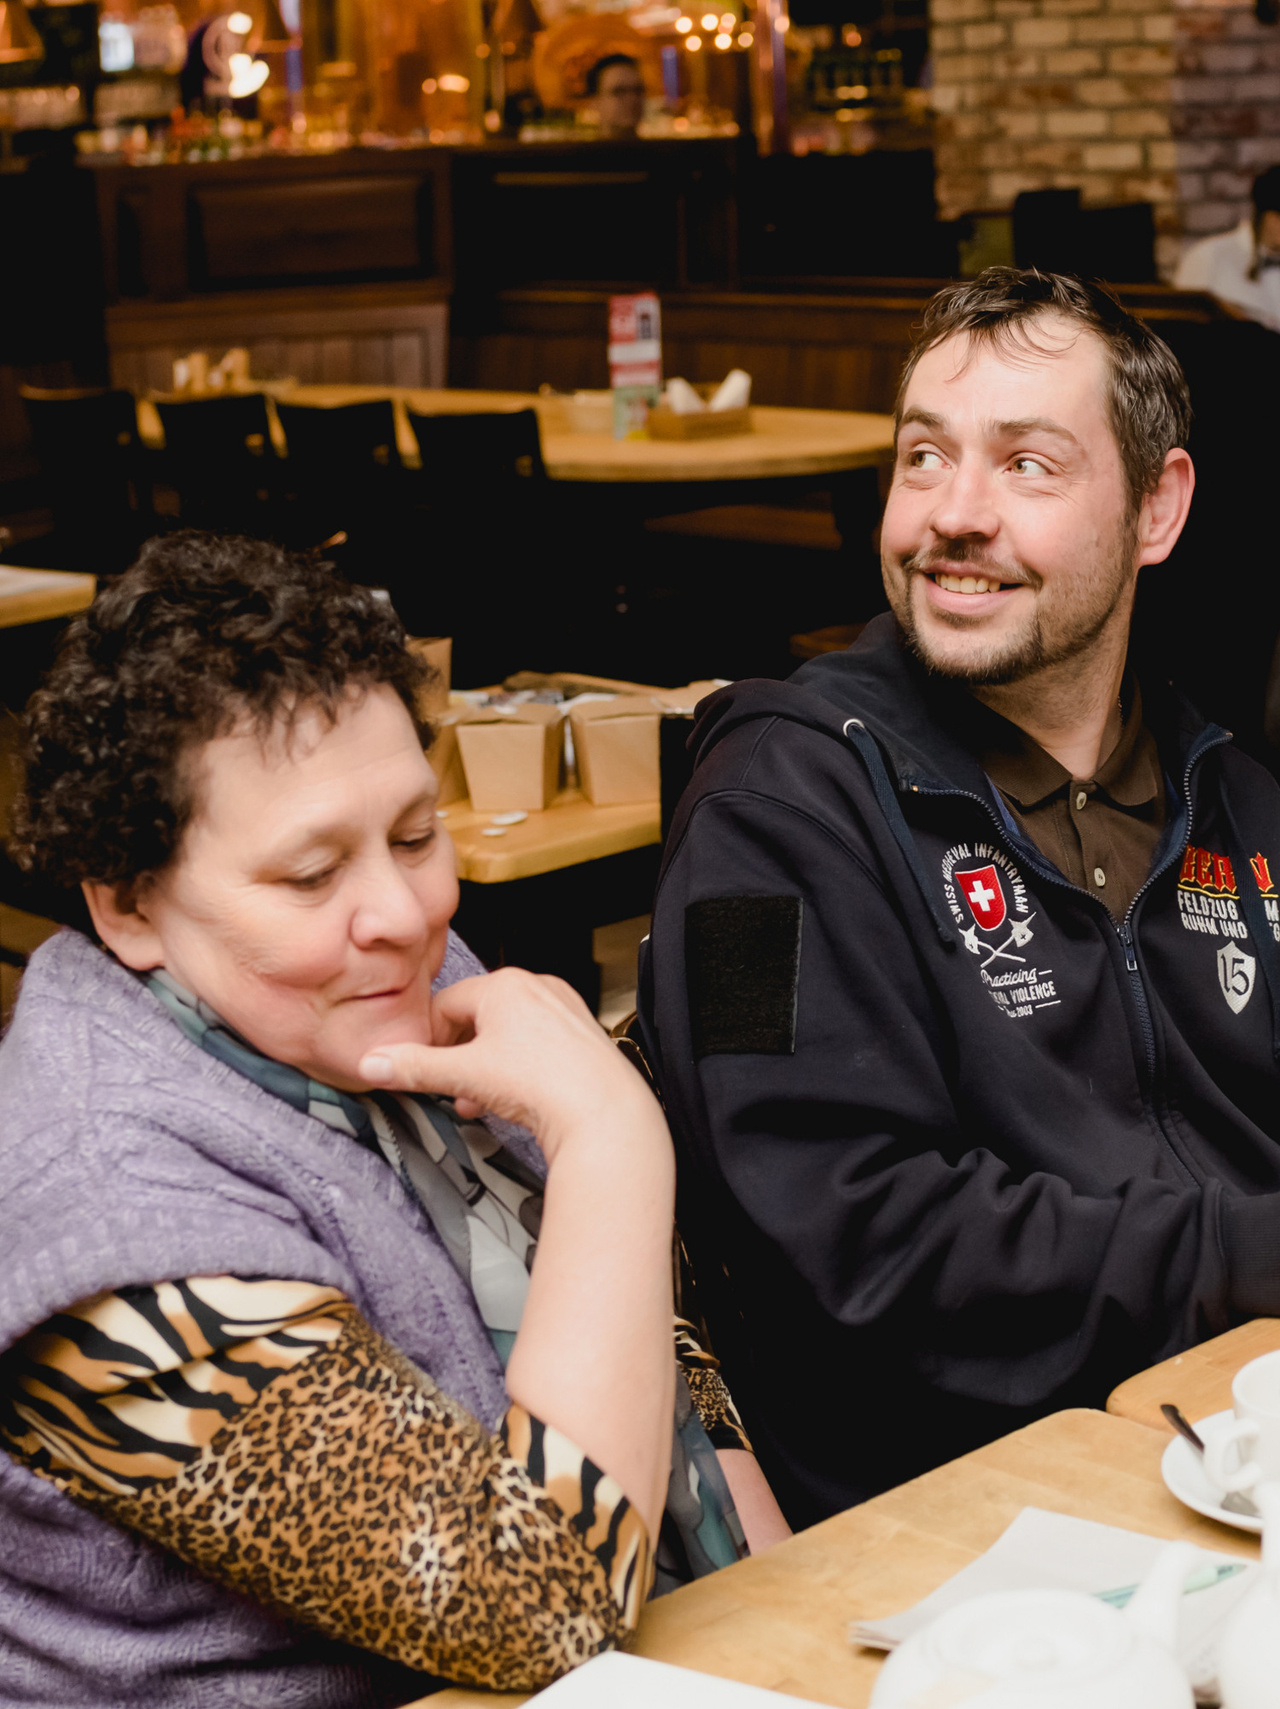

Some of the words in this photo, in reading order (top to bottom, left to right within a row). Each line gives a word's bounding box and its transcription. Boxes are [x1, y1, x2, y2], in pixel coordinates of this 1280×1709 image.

[941, 843, 972, 882] MEDIEVAL
[974, 842, 1029, 914] INFANTRYMAN
[944, 884, 965, 924] SWISS
[1177, 890, 1239, 920] FELDZUG
[1180, 912, 1219, 936] RUHM
[1219, 921, 1248, 939] UND
[980, 967, 1037, 987] Practicing
[1220, 953, 1250, 996] 15
[1010, 981, 1057, 1004] VIOLENCE
